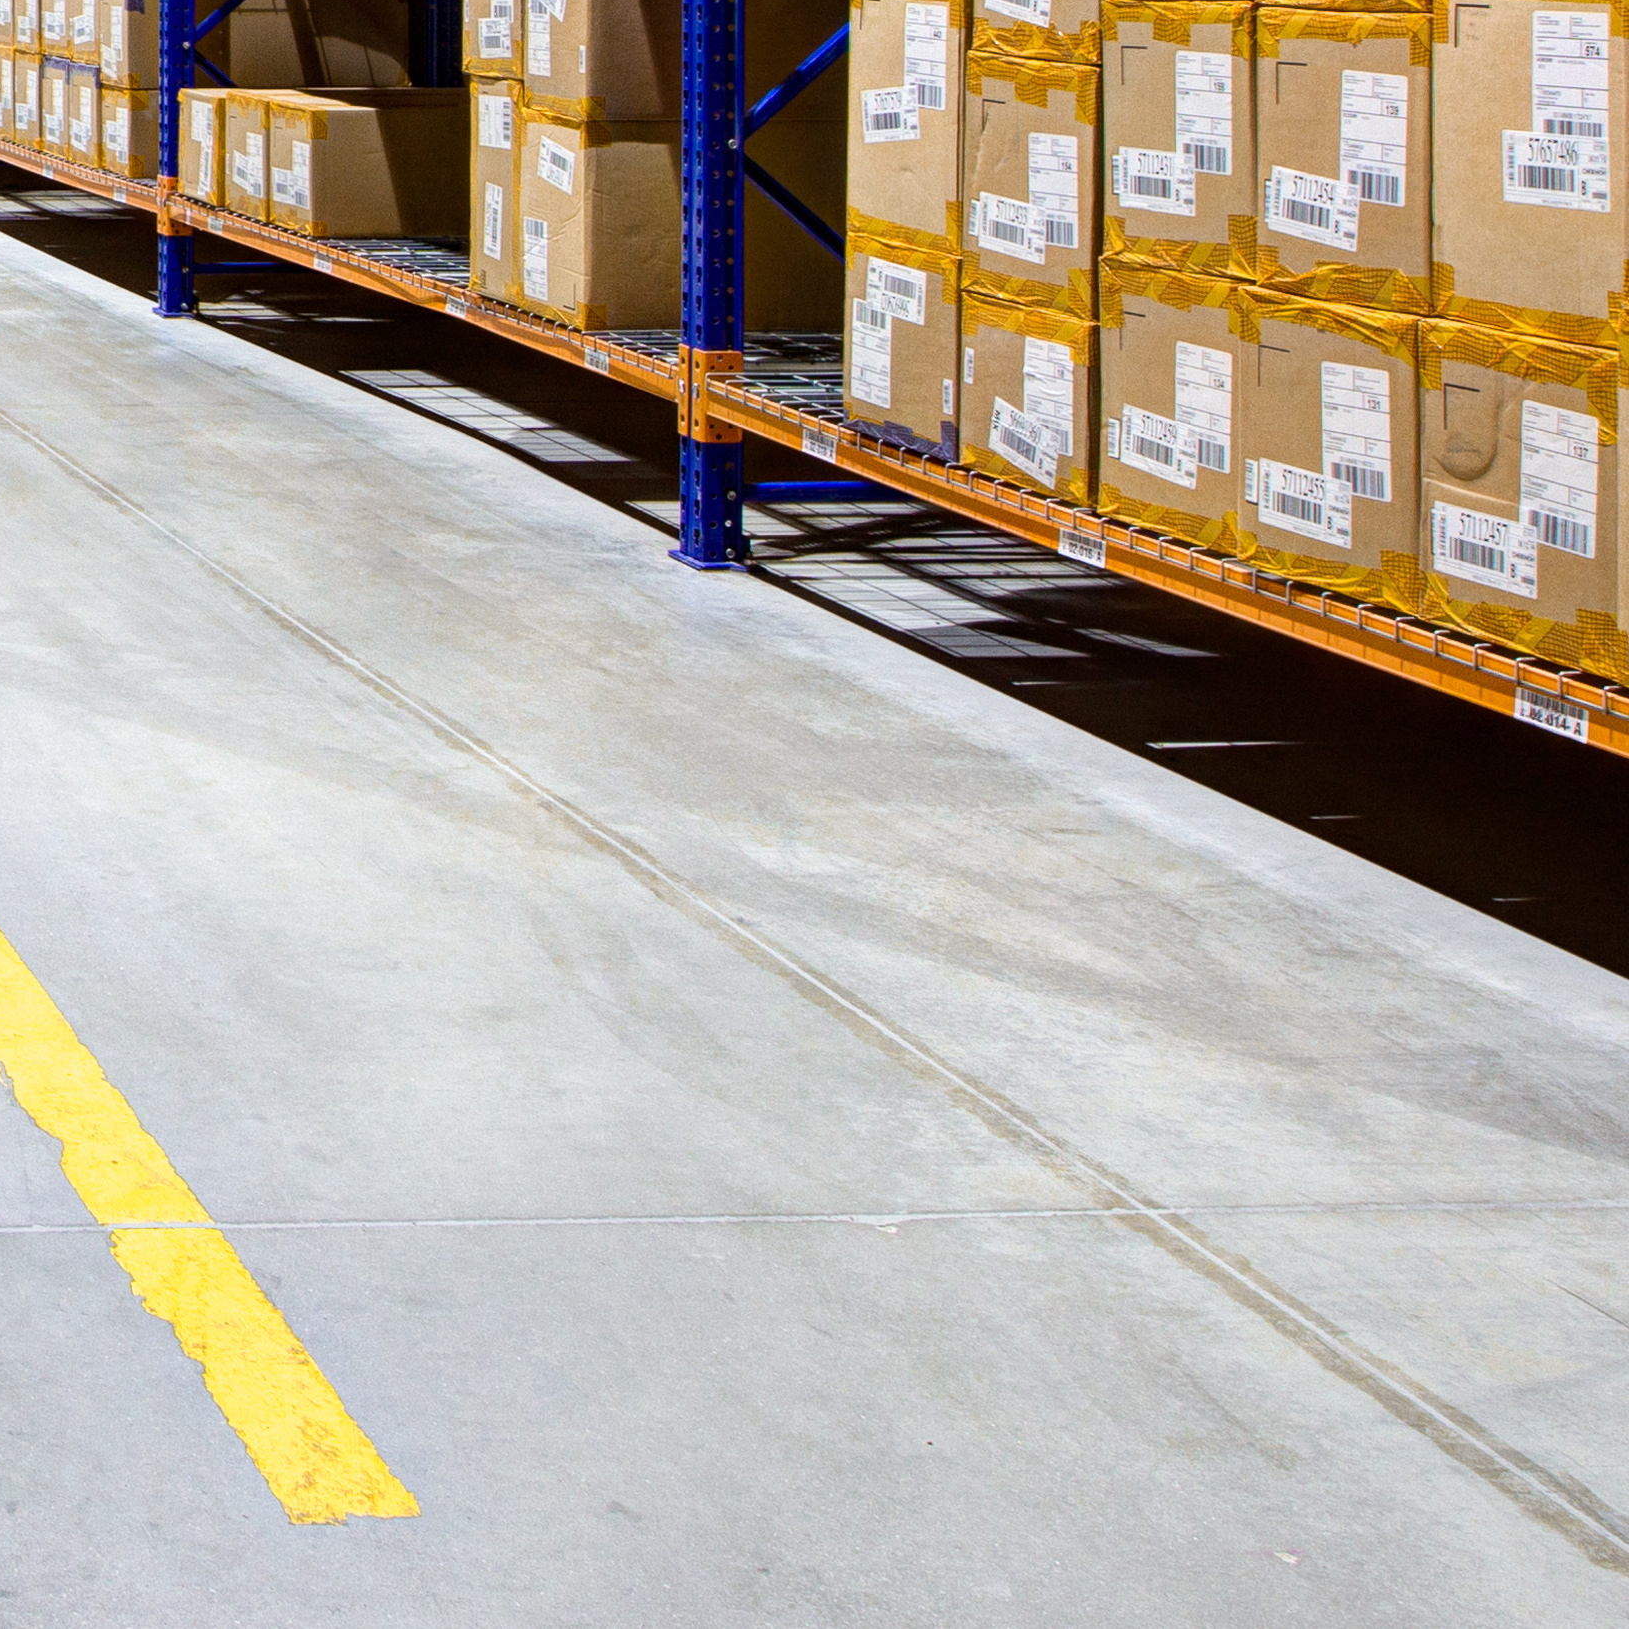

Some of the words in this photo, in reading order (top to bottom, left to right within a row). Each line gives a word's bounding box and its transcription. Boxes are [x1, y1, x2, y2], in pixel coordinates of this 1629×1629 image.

[1527, 137, 1579, 166] 57657486
[1292, 175, 1335, 203] 57112454
[1572, 444, 1589, 458] 137
[1280, 469, 1325, 502] 57112455
[1458, 512, 1508, 544] 57112457
